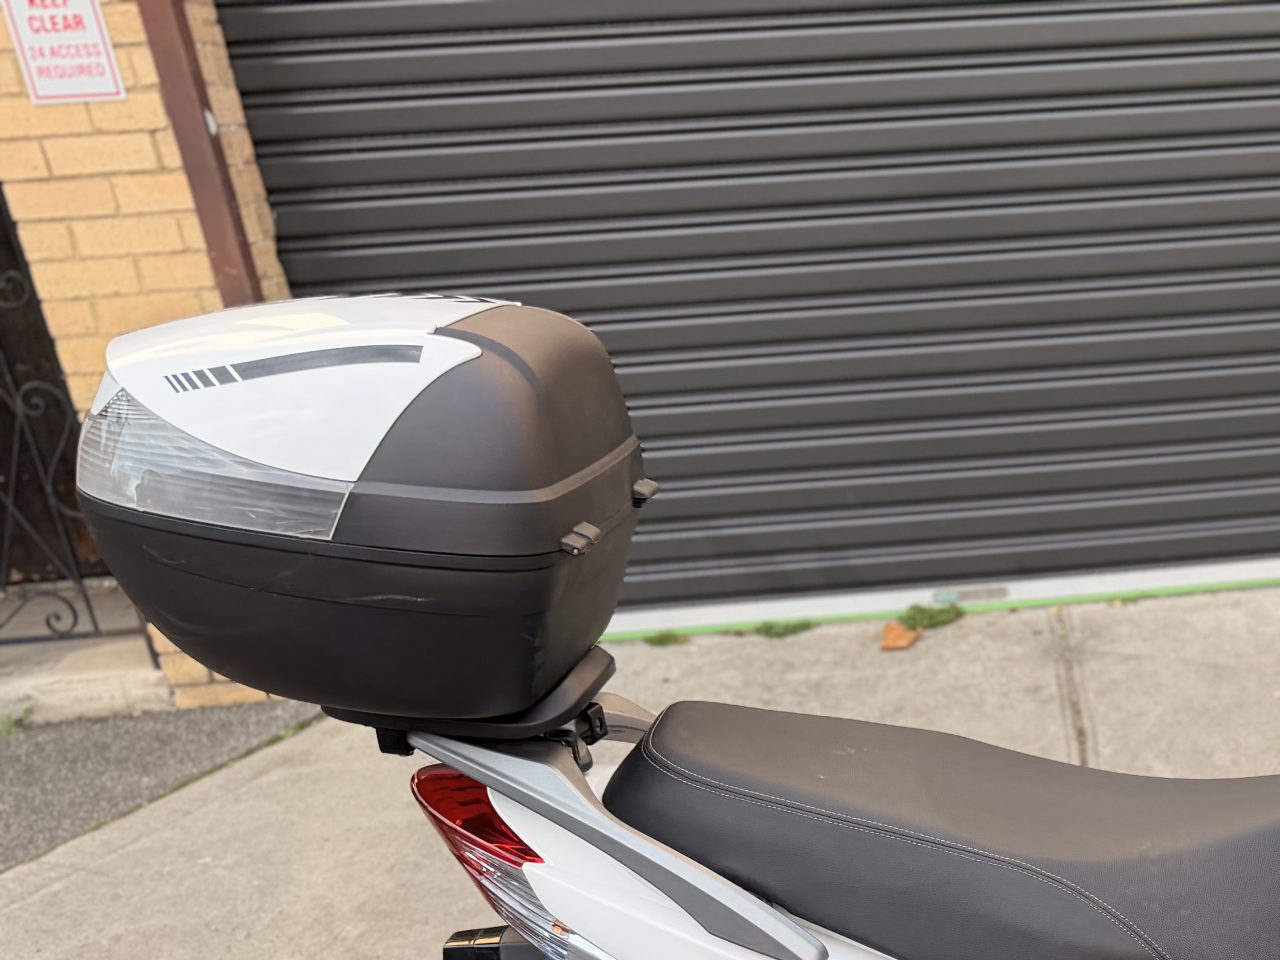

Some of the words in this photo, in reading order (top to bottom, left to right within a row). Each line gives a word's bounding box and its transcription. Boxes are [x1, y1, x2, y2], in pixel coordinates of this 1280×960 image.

[27, 14, 87, 33] CLEAR
[29, 46, 45, 59] 24
[49, 43, 101, 58] ACCESS
[36, 62, 105, 78] REQUIRED
